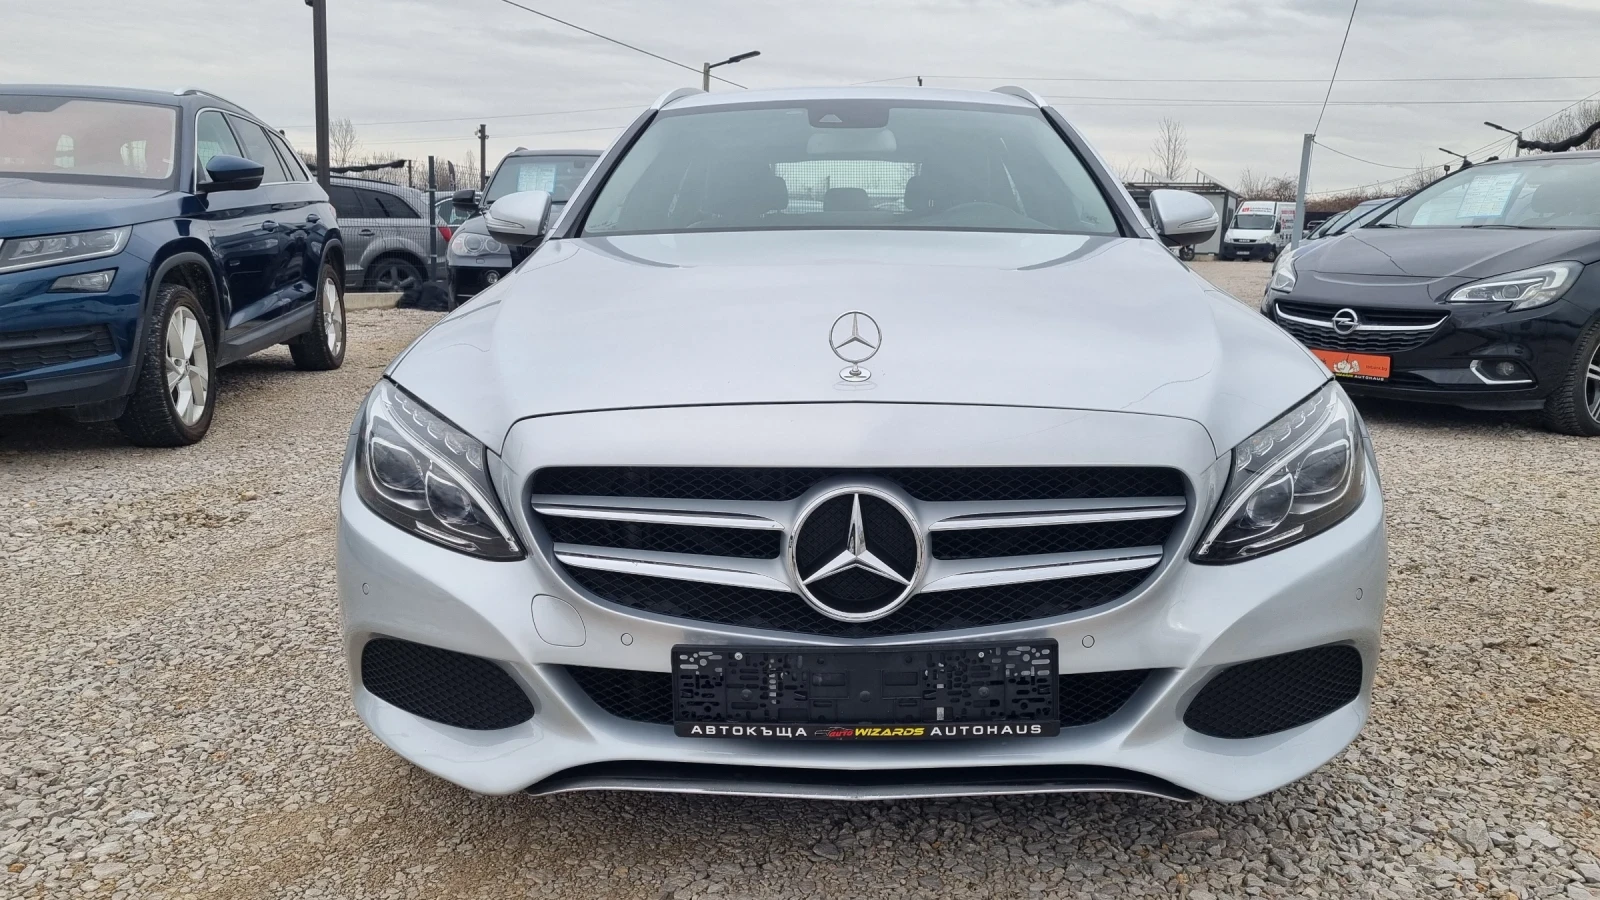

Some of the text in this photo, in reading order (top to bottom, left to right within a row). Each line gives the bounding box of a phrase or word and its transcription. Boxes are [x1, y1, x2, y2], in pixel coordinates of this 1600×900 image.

[1354, 374, 1385, 382] AUTOHAUS
[691, 725, 807, 738] АВТОКЪЩА
[855, 727, 925, 736] WIZARDS
[930, 724, 1042, 736] AUTOHAUS
